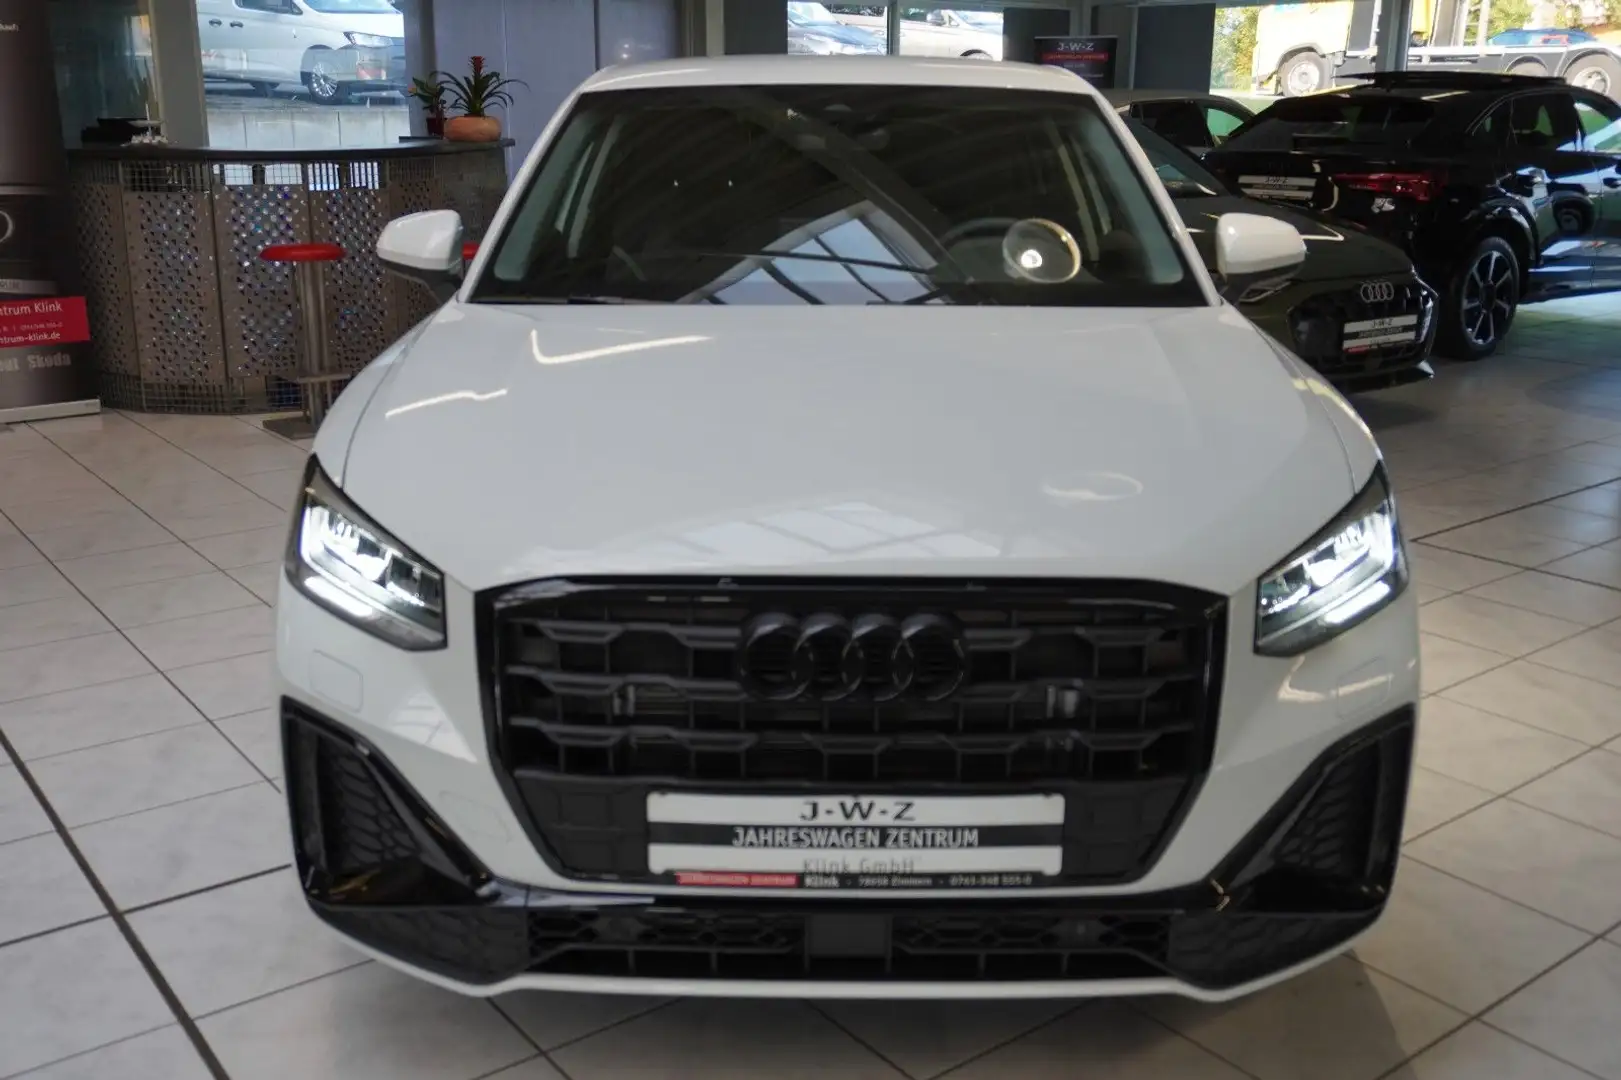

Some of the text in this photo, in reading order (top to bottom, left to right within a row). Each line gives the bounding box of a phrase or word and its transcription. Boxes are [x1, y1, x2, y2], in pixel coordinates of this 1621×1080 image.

[34, 300, 63, 313] Klink
[799, 800, 916, 821] J-W-Z
[732, 826, 979, 848] JAHRESWAGEN ZENTRUM
[803, 857, 915, 874] Klink GmbH
